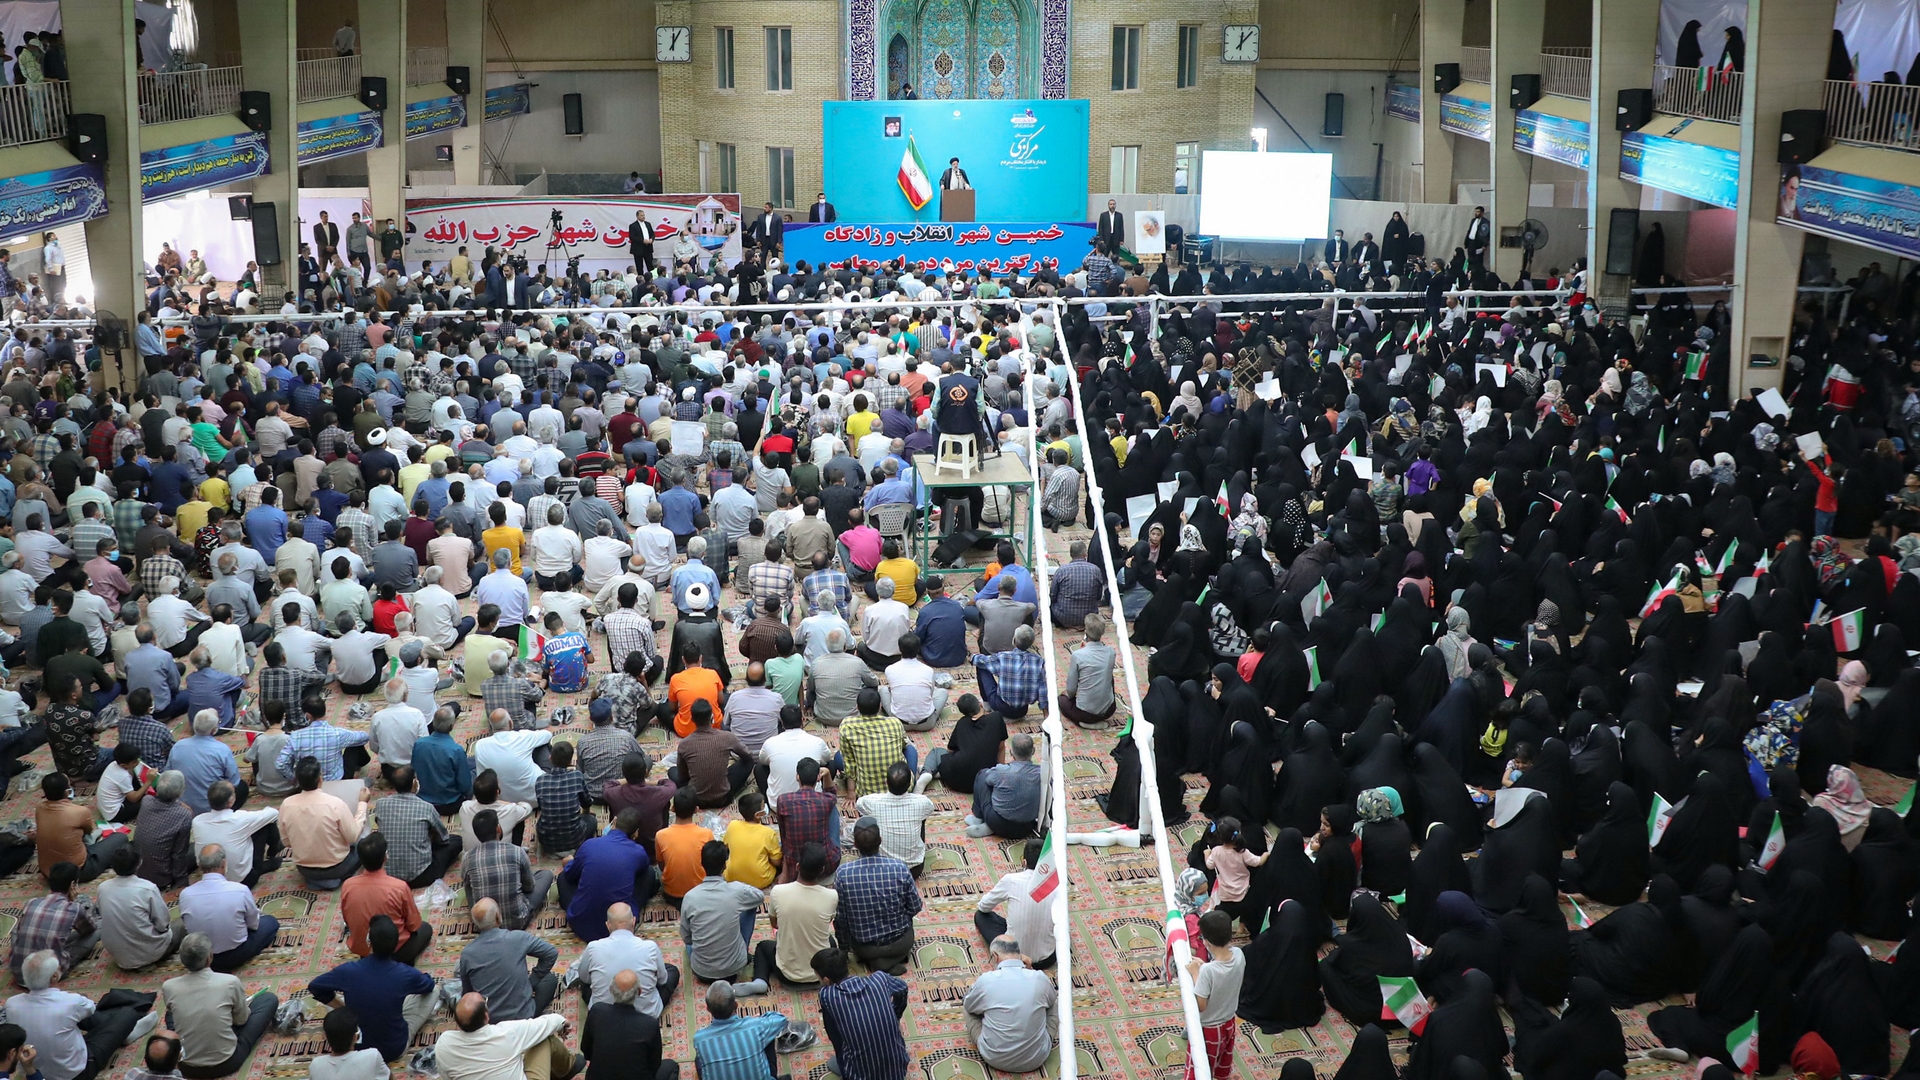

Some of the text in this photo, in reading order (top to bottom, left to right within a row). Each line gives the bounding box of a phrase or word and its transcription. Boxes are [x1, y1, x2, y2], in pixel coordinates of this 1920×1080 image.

[1010, 124, 1046, 160] مرکزی
[229, 152, 239, 167] نماز
[245, 149, 256, 163] رفتن
[167, 169, 176, 180] هم
[192, 163, 206, 177] دیدار
[206, 162, 214, 172] هم
[148, 174, 153, 187] و
[153, 171, 167, 183] زینت
[36, 199, 61, 223] خمینی
[61, 195, 77, 217] امام
[1803, 200, 1819, 215] است
[1818, 203, 1834, 222] زنده
[13, 206, 27, 226] یک
[1840, 211, 1865, 225] محمدی
[1864, 212, 1878, 230] ناب
[1877, 213, 1897, 234] اسلام
[423, 214, 680, 248] خن شهر حزب الله
[823, 223, 1064, 246] خمین شهر انقلاب و زادگاه
[1896, 218, 1903, 235] تا
